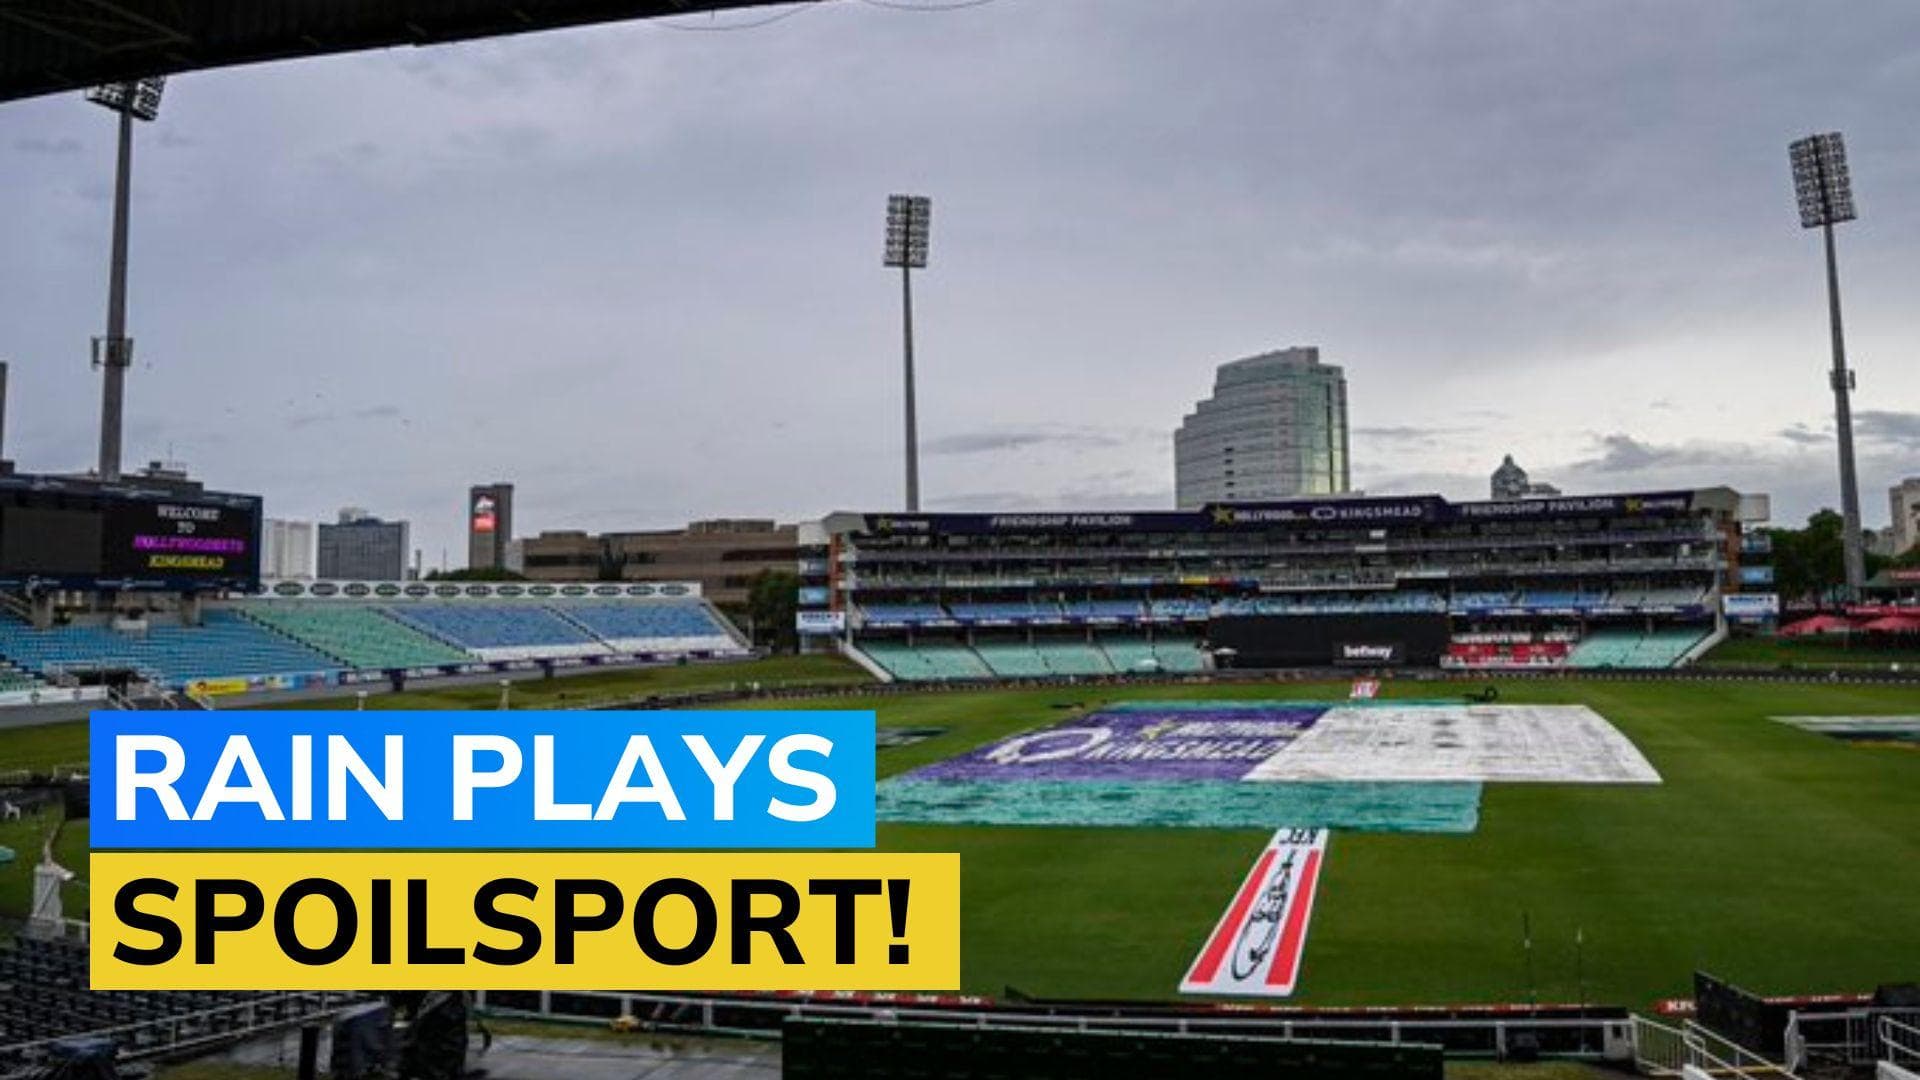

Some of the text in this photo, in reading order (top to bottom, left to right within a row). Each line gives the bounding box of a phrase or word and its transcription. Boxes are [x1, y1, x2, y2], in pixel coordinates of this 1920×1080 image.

[157, 504, 219, 520] WELCOME
[1462, 499, 1615, 516] FRIENDSHIP PAVILION
[177, 521, 196, 534] TO
[990, 514, 1133, 526] FRIENDSHIP PAVILION
[1343, 645, 1392, 660] betway
